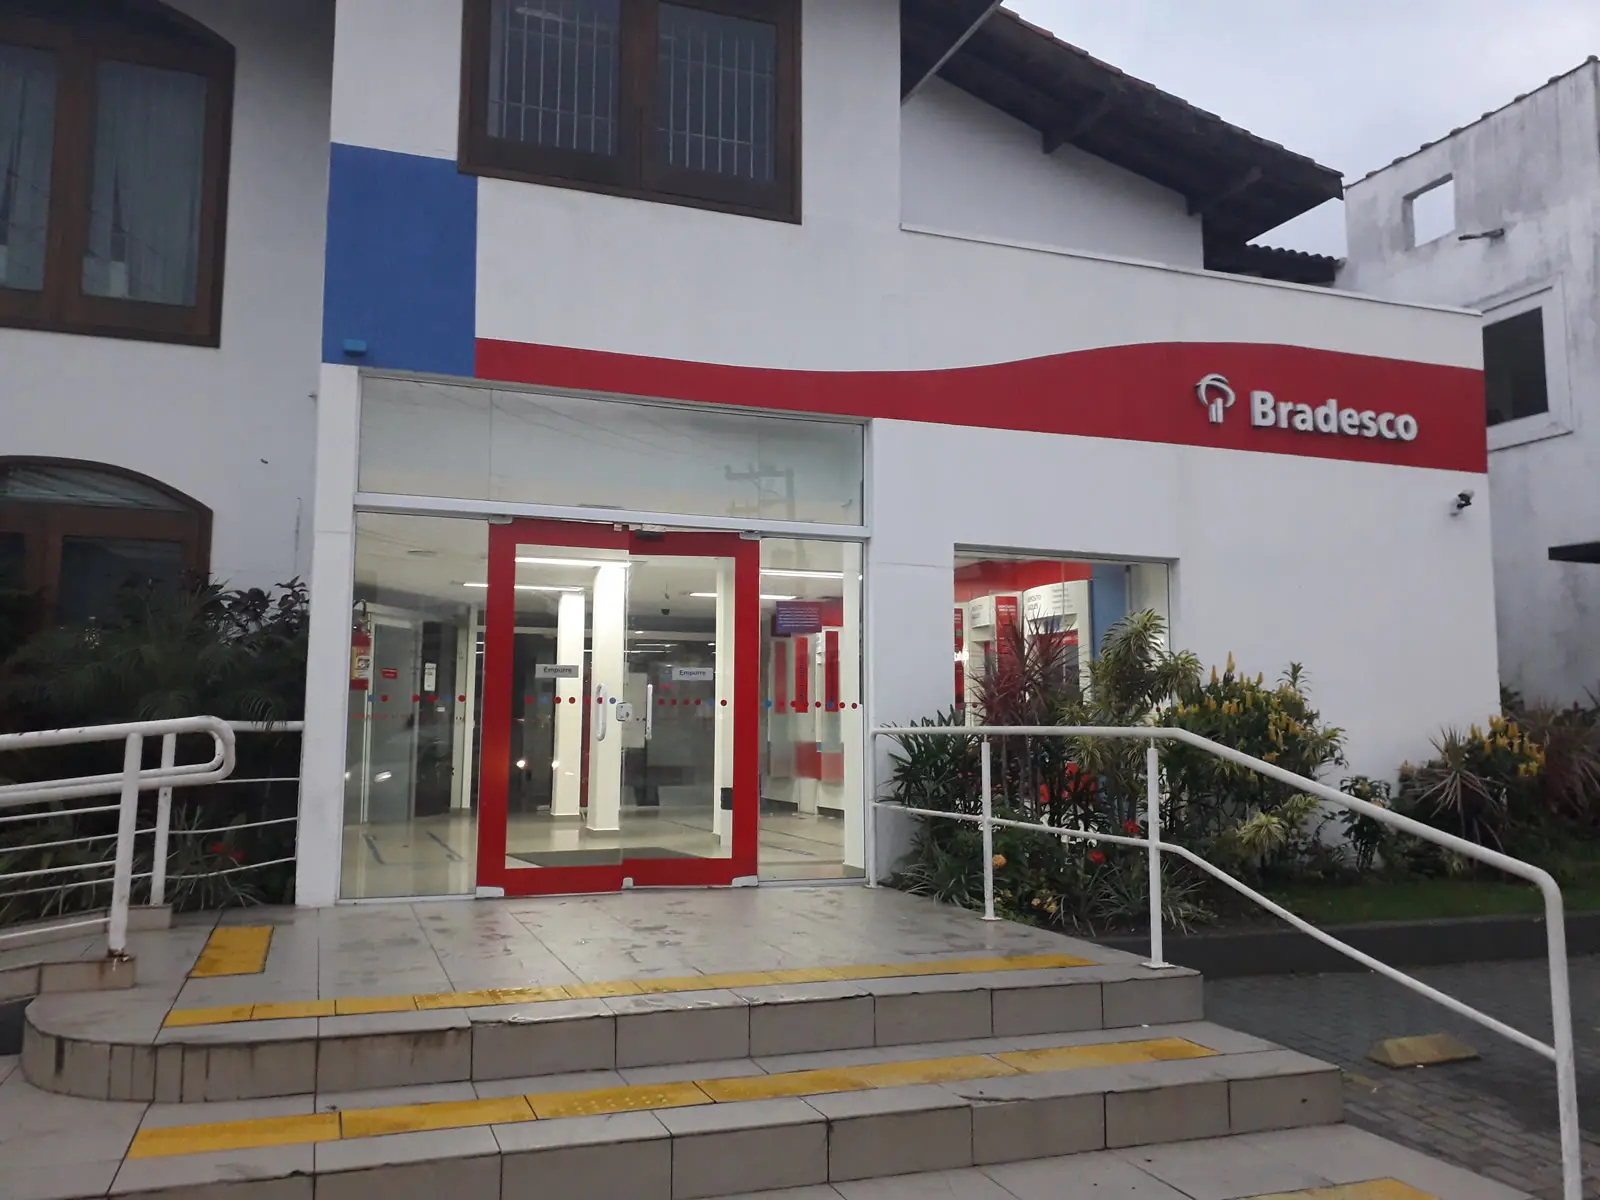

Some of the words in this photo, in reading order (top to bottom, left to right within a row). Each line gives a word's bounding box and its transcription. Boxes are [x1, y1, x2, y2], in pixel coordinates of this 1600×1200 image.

[1250, 390, 1418, 441] Bradesco
[543, 666, 572, 674] Empurre
[679, 669, 707, 677] Empurre
